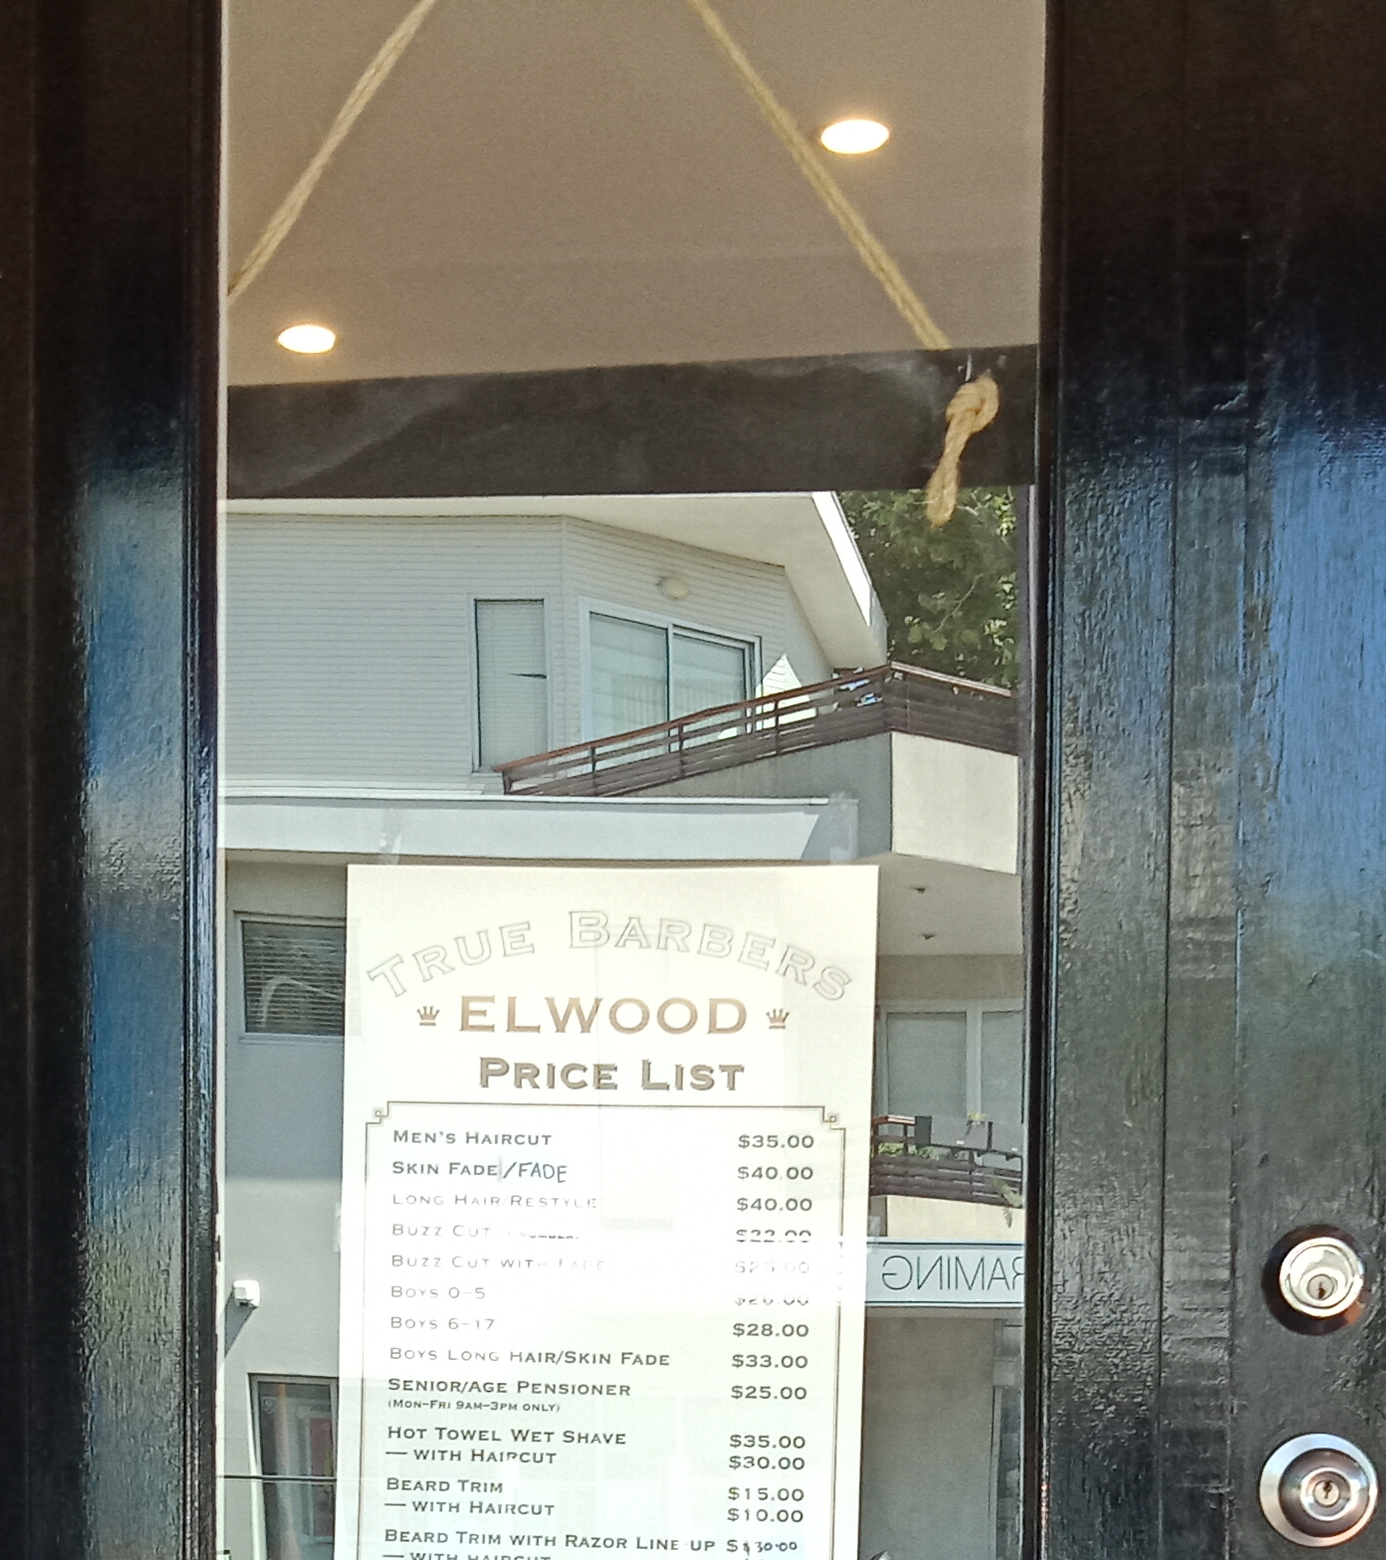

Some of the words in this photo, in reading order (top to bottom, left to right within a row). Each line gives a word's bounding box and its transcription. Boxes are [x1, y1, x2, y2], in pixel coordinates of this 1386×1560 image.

[366, 920, 535, 998] TRUE
[568, 910, 852, 1001] BARBERS
[459, 995, 747, 1035] ELWOOD
[479, 1056, 618, 1090] PRICE
[640, 1059, 745, 1092] LIST
[393, 1130, 456, 1144] MEN'S
[465, 1132, 552, 1146] HAIRCUT
[738, 1134, 814, 1149] $35.00
[392, 1161, 439, 1175] SKIN
[737, 1166, 813, 1180] $40.00
[393, 1194, 444, 1206] LONG
[736, 1197, 813, 1212] $40.00
[392, 1223, 443, 1237] BUZZ
[453, 1225, 491, 1238] CUT
[391, 1254, 442, 1268] BUZZ
[452, 1255, 490, 1269] CUT
[391, 1285, 439, 1299] BOYS
[390, 1316, 438, 1330] BOYS
[448, 1317, 495, 1331] 6-17
[732, 1321, 809, 1338] $28.00
[389, 1347, 438, 1361] BOYS
[448, 1349, 500, 1362] LONG
[510, 1351, 611, 1365] HAIR/SKIN
[620, 1351, 670, 1366] FADE
[731, 1352, 809, 1370] $33.00
[388, 1378, 507, 1394] SENIOR/AGE
[517, 1380, 631, 1397] PENSIONER
[730, 1384, 808, 1401] $25.00
[523, 1402, 561, 1414] ONLY)
[387, 1426, 427, 1440] HOT
[435, 1426, 502, 1442] TOWEL
[511, 1428, 555, 1443] WET
[562, 1430, 627, 1445] SHAVE
[729, 1434, 806, 1449] $35.00
[413, 1449, 462, 1462] WITH
[470, 1449, 557, 1464] HAIRCUT
[728, 1455, 805, 1470] $30.00
[386, 1477, 450, 1492] BEARD
[457, 1479, 503, 1493] TRIM
[727, 1486, 804, 1502] $15.00
[412, 1501, 460, 1513] WITH
[469, 1501, 555, 1516] HAIRCUT
[727, 1508, 803, 1523] $10.00
[385, 1529, 448, 1544] BEARD
[456, 1531, 501, 1545] TRIM
[509, 1534, 557, 1547] WITH
[564, 1534, 628, 1550] RAZOR
[636, 1537, 680, 1551] LINE
[690, 1540, 716, 1551] UP
